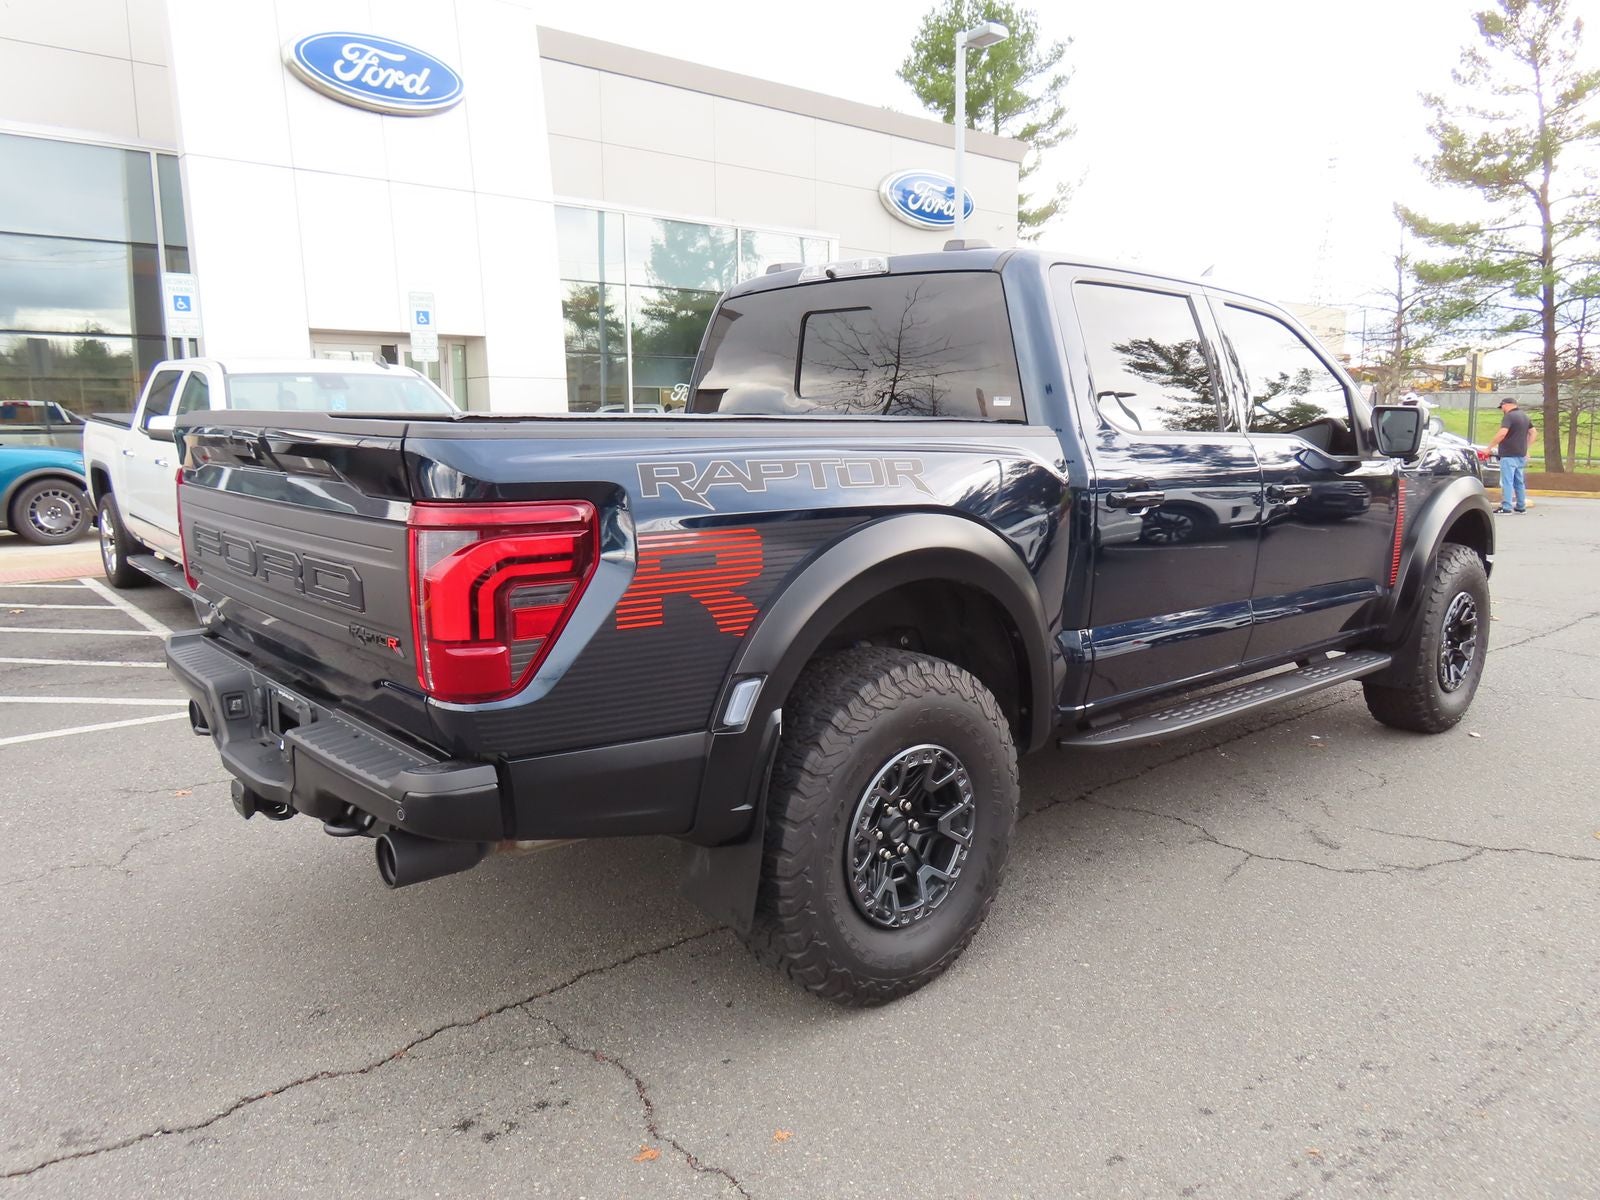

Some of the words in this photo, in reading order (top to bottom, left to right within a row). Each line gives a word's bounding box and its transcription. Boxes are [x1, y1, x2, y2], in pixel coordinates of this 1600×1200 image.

[333, 42, 431, 96] Ford
[636, 457, 937, 511] RAPTOR
[193, 521, 366, 614] FORD
[615, 528, 764, 637] R
[349, 622, 406, 658] RAPTOR
